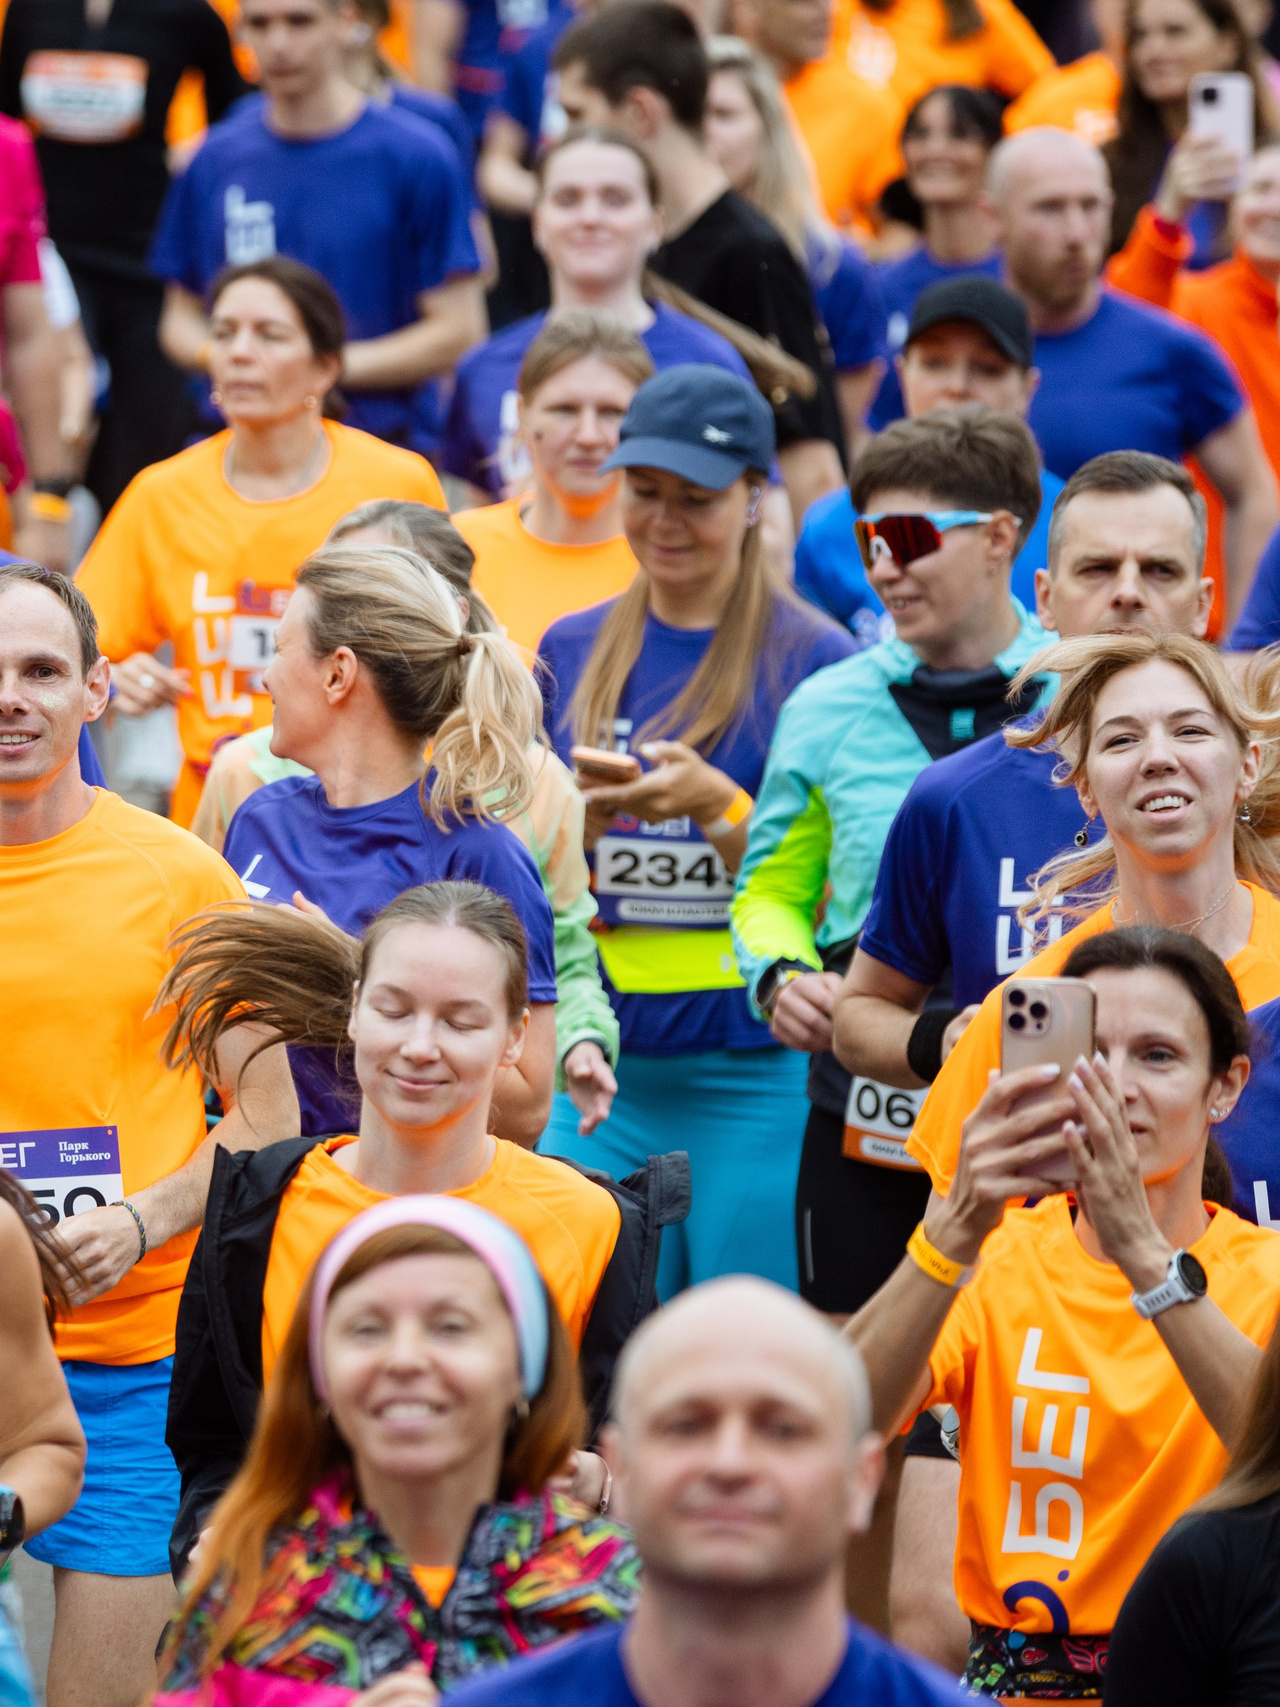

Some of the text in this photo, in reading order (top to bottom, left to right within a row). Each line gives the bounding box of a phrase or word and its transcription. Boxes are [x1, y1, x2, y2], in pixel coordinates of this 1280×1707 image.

[610, 851, 734, 888] 234
[58, 1141, 90, 1153] Парк
[59, 1152, 112, 1166] Горького
[1001, 1326, 1091, 1561] БЕГ
